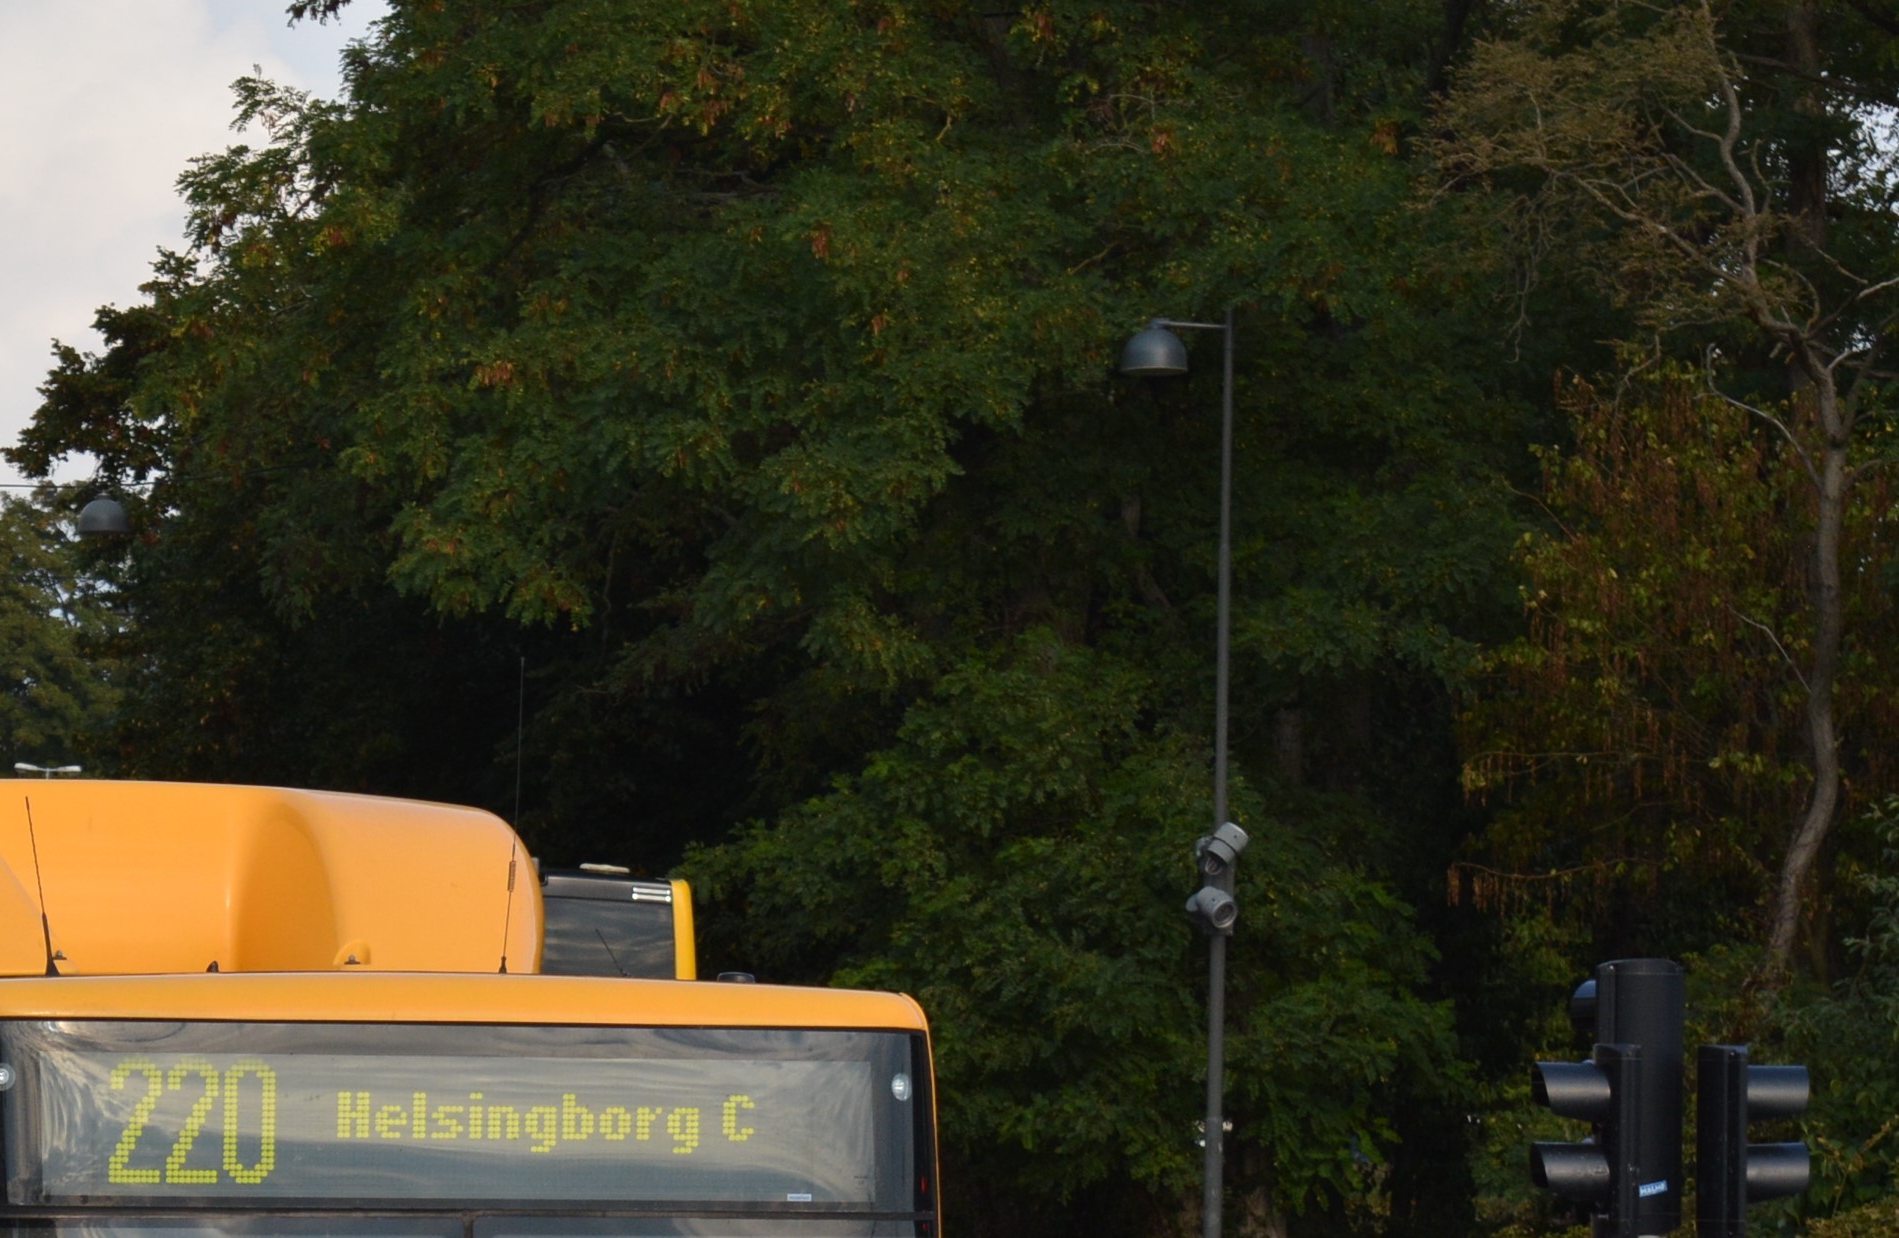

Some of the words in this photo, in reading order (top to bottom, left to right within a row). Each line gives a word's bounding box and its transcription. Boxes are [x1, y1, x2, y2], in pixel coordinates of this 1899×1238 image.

[108, 1056, 276, 1184] 220
[337, 1091, 700, 1154] Helsingborg
[722, 1094, 755, 1141] C
